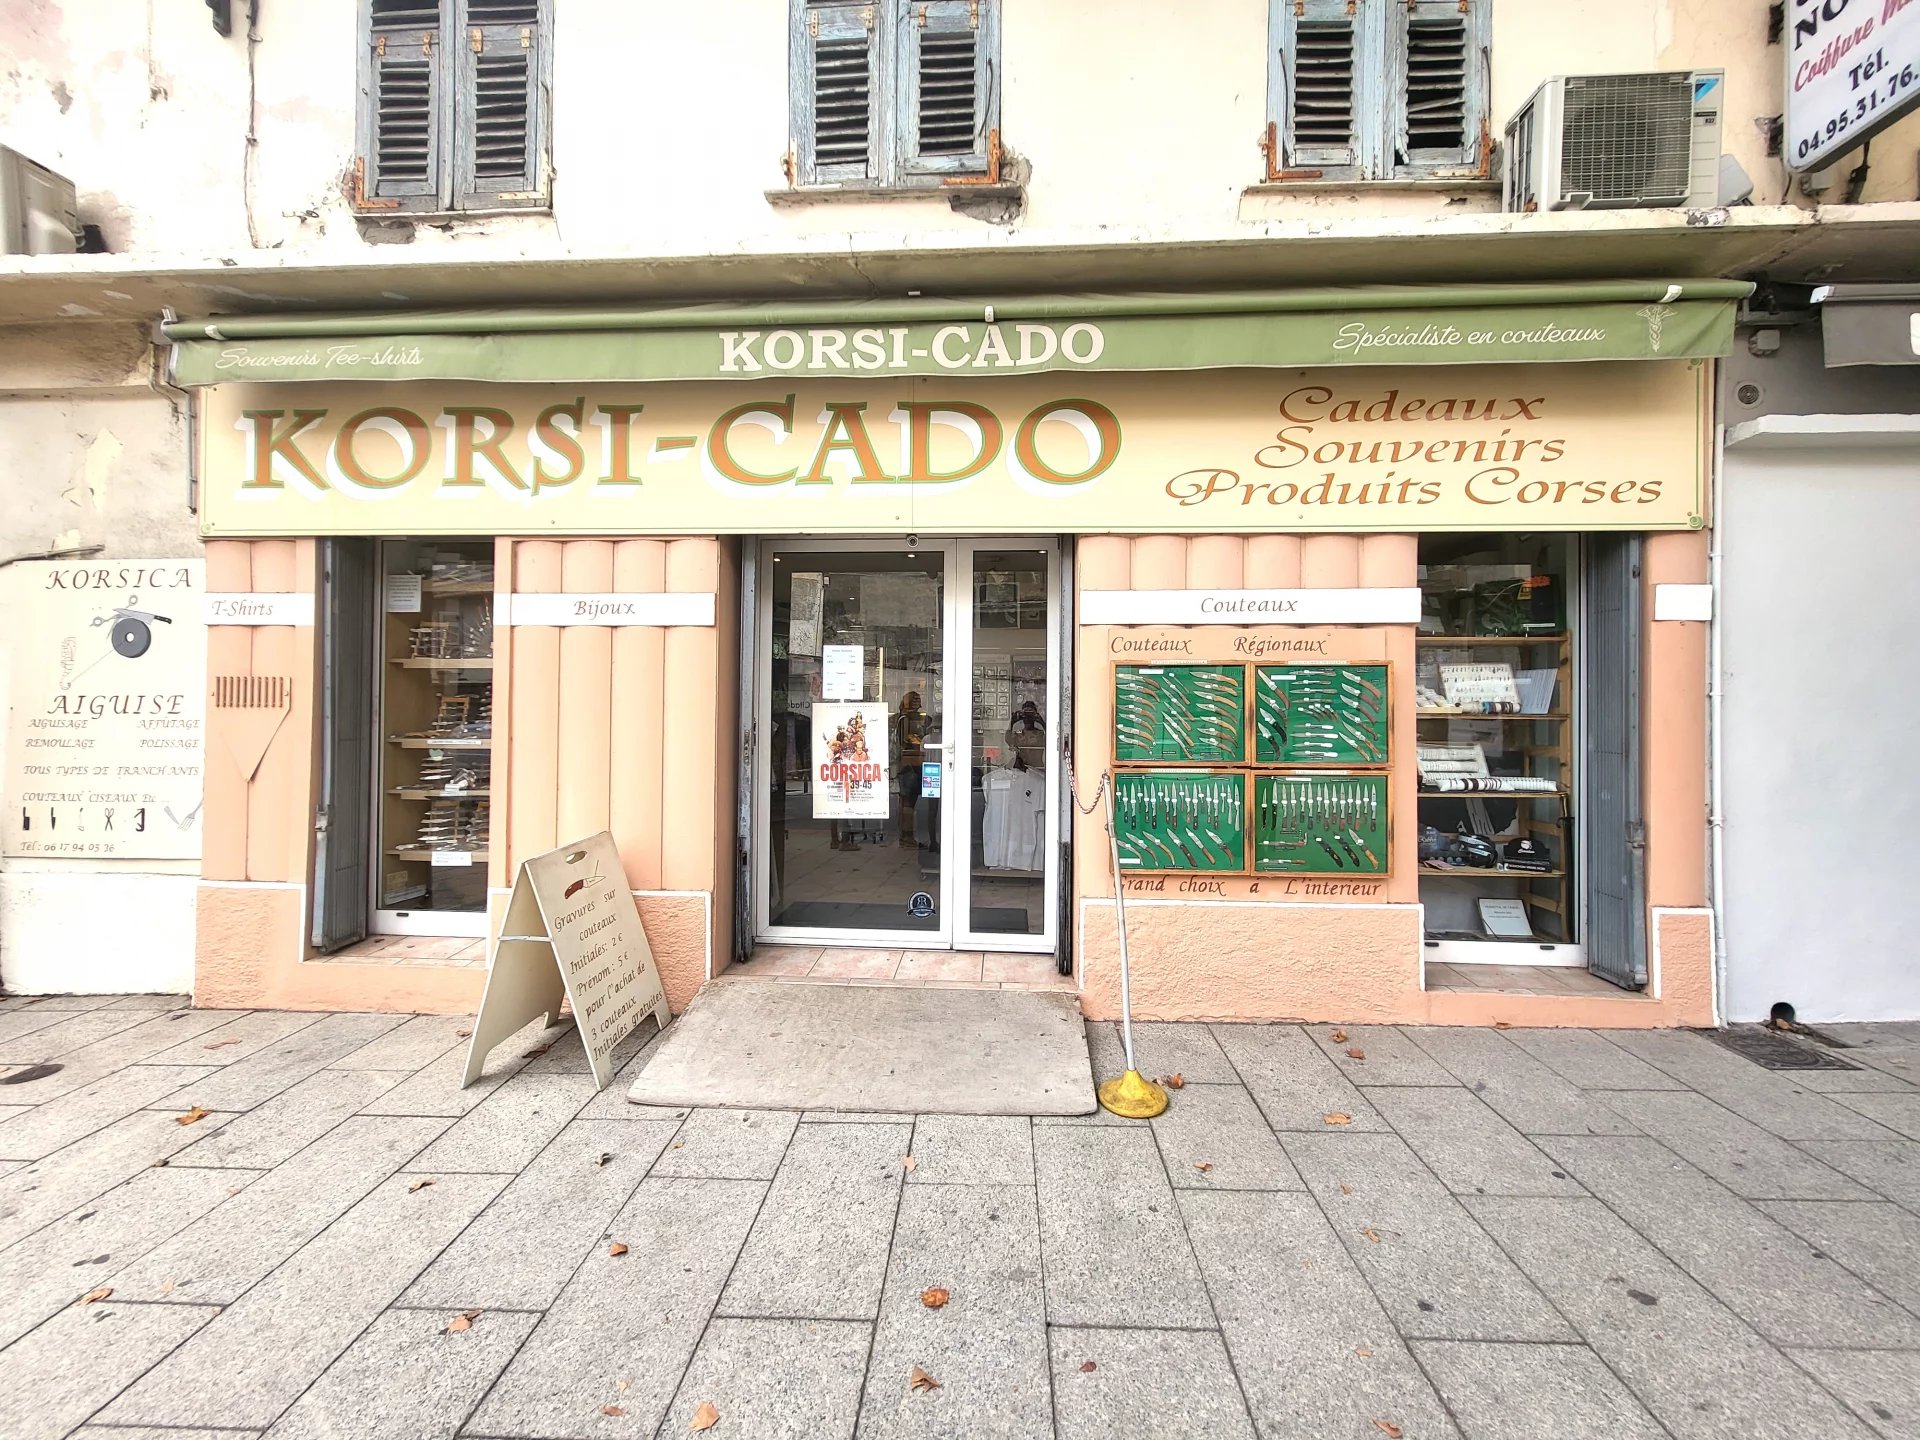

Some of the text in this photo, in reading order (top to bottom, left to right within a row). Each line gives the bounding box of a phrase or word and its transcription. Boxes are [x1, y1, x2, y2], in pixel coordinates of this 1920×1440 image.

[1794, 17, 1874, 92] Coiffure
[1848, 47, 1890, 91] Tél.
[718, 322, 1105, 373] KORSI-CADO
[1332, 321, 1606, 355] Spécialiste en couteaux
[214, 344, 424, 369] Souvenirs Tee-shirts
[1278, 385, 1545, 424] Cadeaux
[239, 392, 1123, 498] KORSI-CADO
[1253, 425, 1566, 469] Souvenirs
[1164, 465, 1664, 507] Produits Corses
[45, 567, 193, 590] KORSICA
[211, 598, 275, 617] T-Shirts
[573, 599, 637, 621] Bijoux
[1200, 596, 1299, 614] Couteaux
[1110, 635, 1329, 657] Couteaux Régionaux
[46, 693, 185, 720] AIGUISE
[27, 718, 89, 730] AIGUISAGE
[23, 765, 52, 775] TOUS
[92, 765, 110, 775] DE
[820, 763, 882, 782] CORSICA
[1178, 874, 1227, 897] choix
[554, 888, 616, 933] Gravures sur
[579, 912, 617, 942] couteaux
[585, 993, 606, 1023] pour
[637, 960, 646, 976] de
[593, 990, 663, 1062] Initiales gratuites
[600, 995, 637, 1034] couteaux
